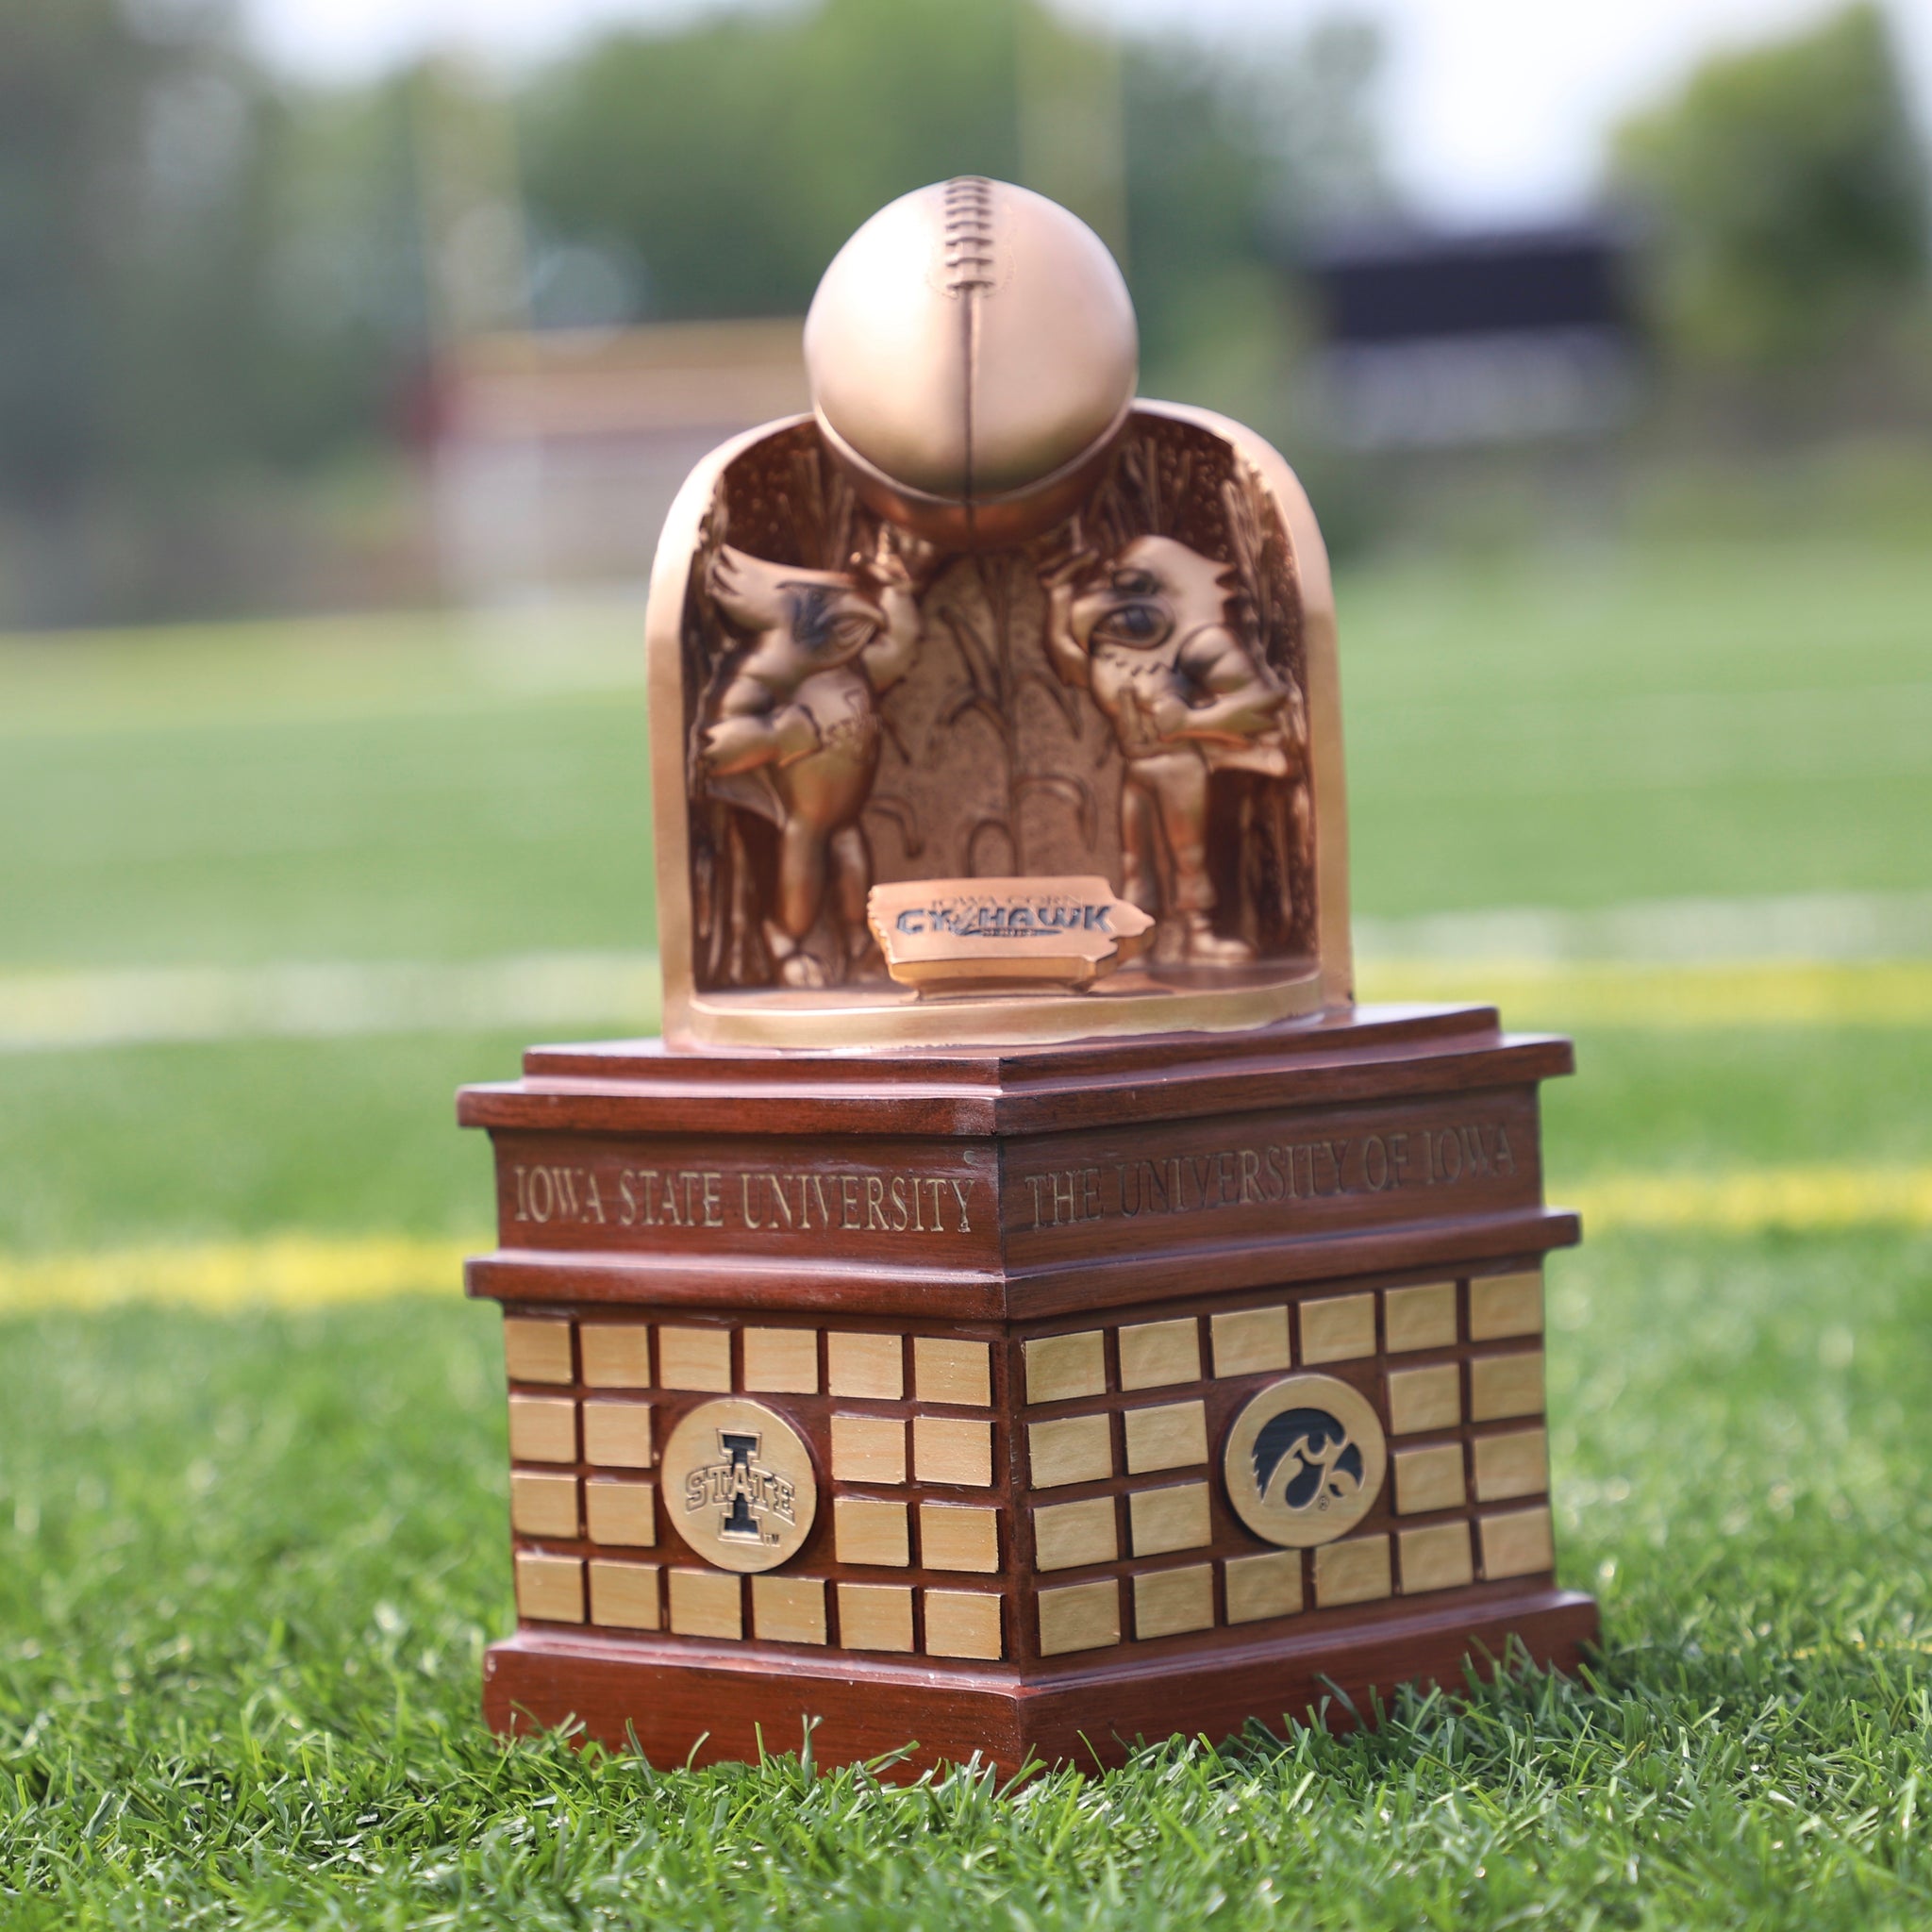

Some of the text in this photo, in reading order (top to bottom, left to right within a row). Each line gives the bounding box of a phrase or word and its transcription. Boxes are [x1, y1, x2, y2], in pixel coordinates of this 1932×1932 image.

[514, 1165, 974, 1233] IOWA STATE UNIVERSITY
[1025, 1124, 1518, 1229] THE UNIVERSITY OF IOWA
[686, 1463, 796, 1526] STATE
